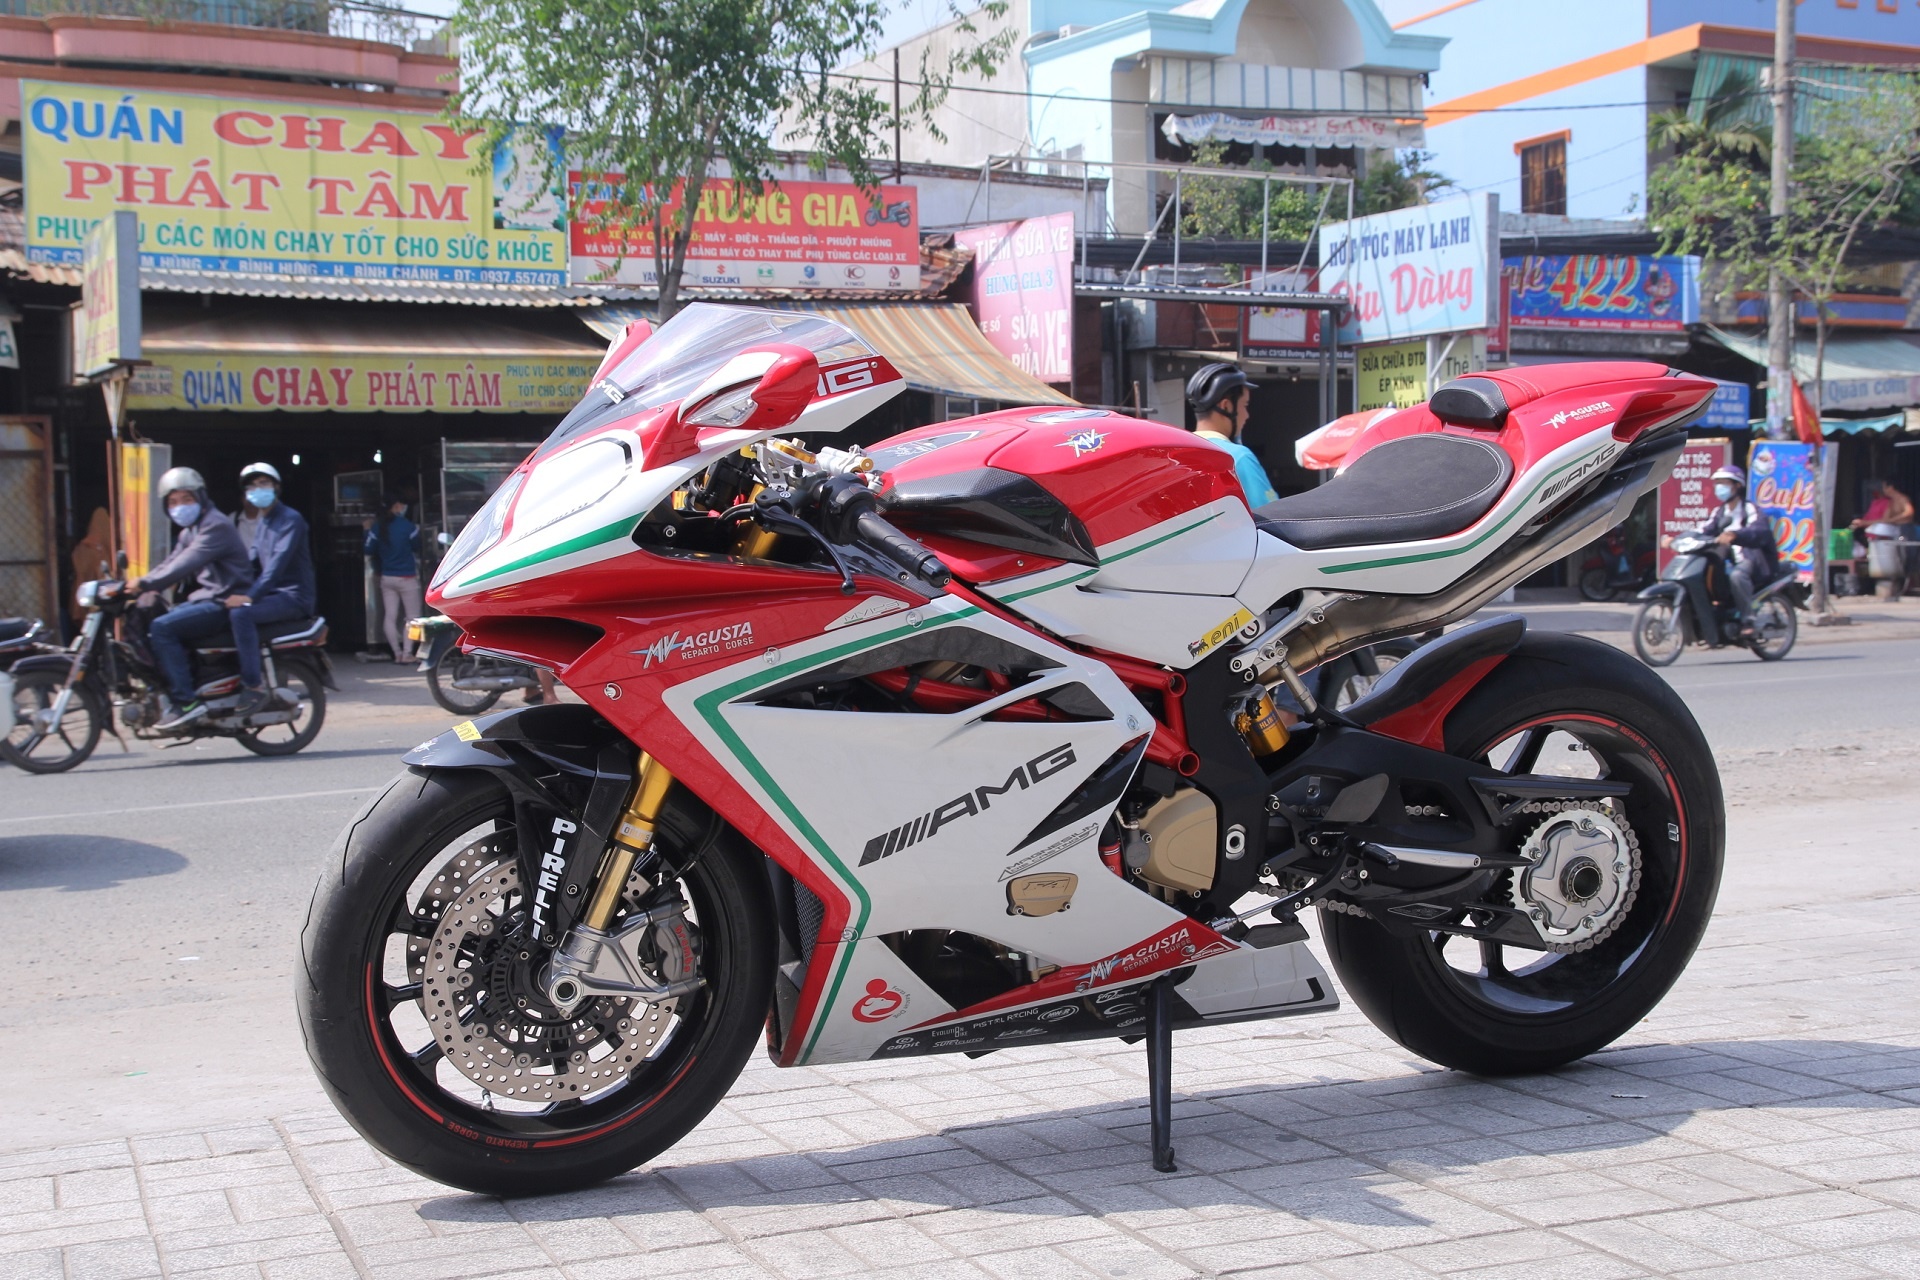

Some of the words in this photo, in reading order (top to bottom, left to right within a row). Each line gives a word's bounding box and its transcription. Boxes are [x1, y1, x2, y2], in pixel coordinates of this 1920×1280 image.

[30, 95, 183, 144] QUÁN
[213, 110, 486, 160] CHAY
[63, 158, 230, 211] PHÁT
[307, 169, 469, 222] TÂM
[694, 181, 792, 226] HÙNG
[802, 192, 860, 227] GIA
[156, 219, 203, 247] CÁC
[213, 222, 265, 250] MÓN
[274, 229, 334, 255] CHAY
[342, 226, 386, 255] TỐT
[394, 235, 439, 260] CHO
[447, 232, 489, 260] SỨC
[497, 233, 554, 262] KHỎE
[640, 246, 652, 255] XE
[719, 247, 740, 258] MÁY
[742, 248, 756, 258] CÓ
[758, 249, 782, 259] THAY
[785, 247, 803, 260] THẾ
[805, 250, 824, 261] PHỤ
[827, 249, 851, 261] TÙNG
[853, 249, 871, 261] CÁC
[873, 253, 893, 263] LOẠI
[895, 253, 907, 262] XE
[704, 230, 726, 243] MÁY
[735, 232, 759, 245] ĐIỆN
[826, 236, 857, 247] PHUỘT
[975, 233, 1011, 266] TIỆM
[1015, 224, 1045, 258] SỬA
[1050, 226, 1069, 254] XE
[1362, 228, 1389, 260] TÓC
[1394, 220, 1425, 256] MÁY
[1430, 216, 1471, 255] LẠNH
[160, 254, 202, 271] HÙNG
[239, 257, 274, 274] BÌNH
[354, 261, 388, 279] BÌNH
[392, 262, 439, 280] CHÁNH
[453, 267, 476, 282] ĐT:
[480, 270, 560, 285] 0937.557478
[702, 276, 740, 285] SUZUKI
[986, 273, 1018, 296] HÙNG
[1021, 272, 1042, 292] GIA
[1045, 269, 1055, 291] 3
[1550, 254, 1640, 313] 422
[1390, 263, 1474, 312] Dàng
[1011, 306, 1040, 341] SỬA
[1044, 309, 1069, 376] XE
[1362, 350, 1379, 372] SỬA
[1382, 350, 1405, 370] CHỮA
[183, 361, 242, 408] QUÁN
[252, 366, 354, 406] CHAY
[367, 362, 437, 406] PHÁT
[446, 363, 502, 406] TÂM
[538, 384, 555, 397] CHO
[1379, 375, 1390, 392] ÉP
[1570, 401, 1611, 418] AGUSTA
[681, 621, 752, 650] AGUSTA
[1210, 613, 1240, 646] eni
[681, 645, 720, 660] REPARTO
[725, 636, 754, 651] CORSE
[927, 742, 1077, 838] AMG
[531, 817, 577, 940] PIRELLI
[675, 924, 694, 972] brembo
[1122, 928, 1189, 965] AGUSTA
[1123, 952, 1159, 973] REPARTO
[1164, 938, 1192, 955] CORSE
[887, 1041, 920, 1051] capit
[447, 1121, 479, 1141] CORSE
[485, 1135, 529, 1149] REPARTO
